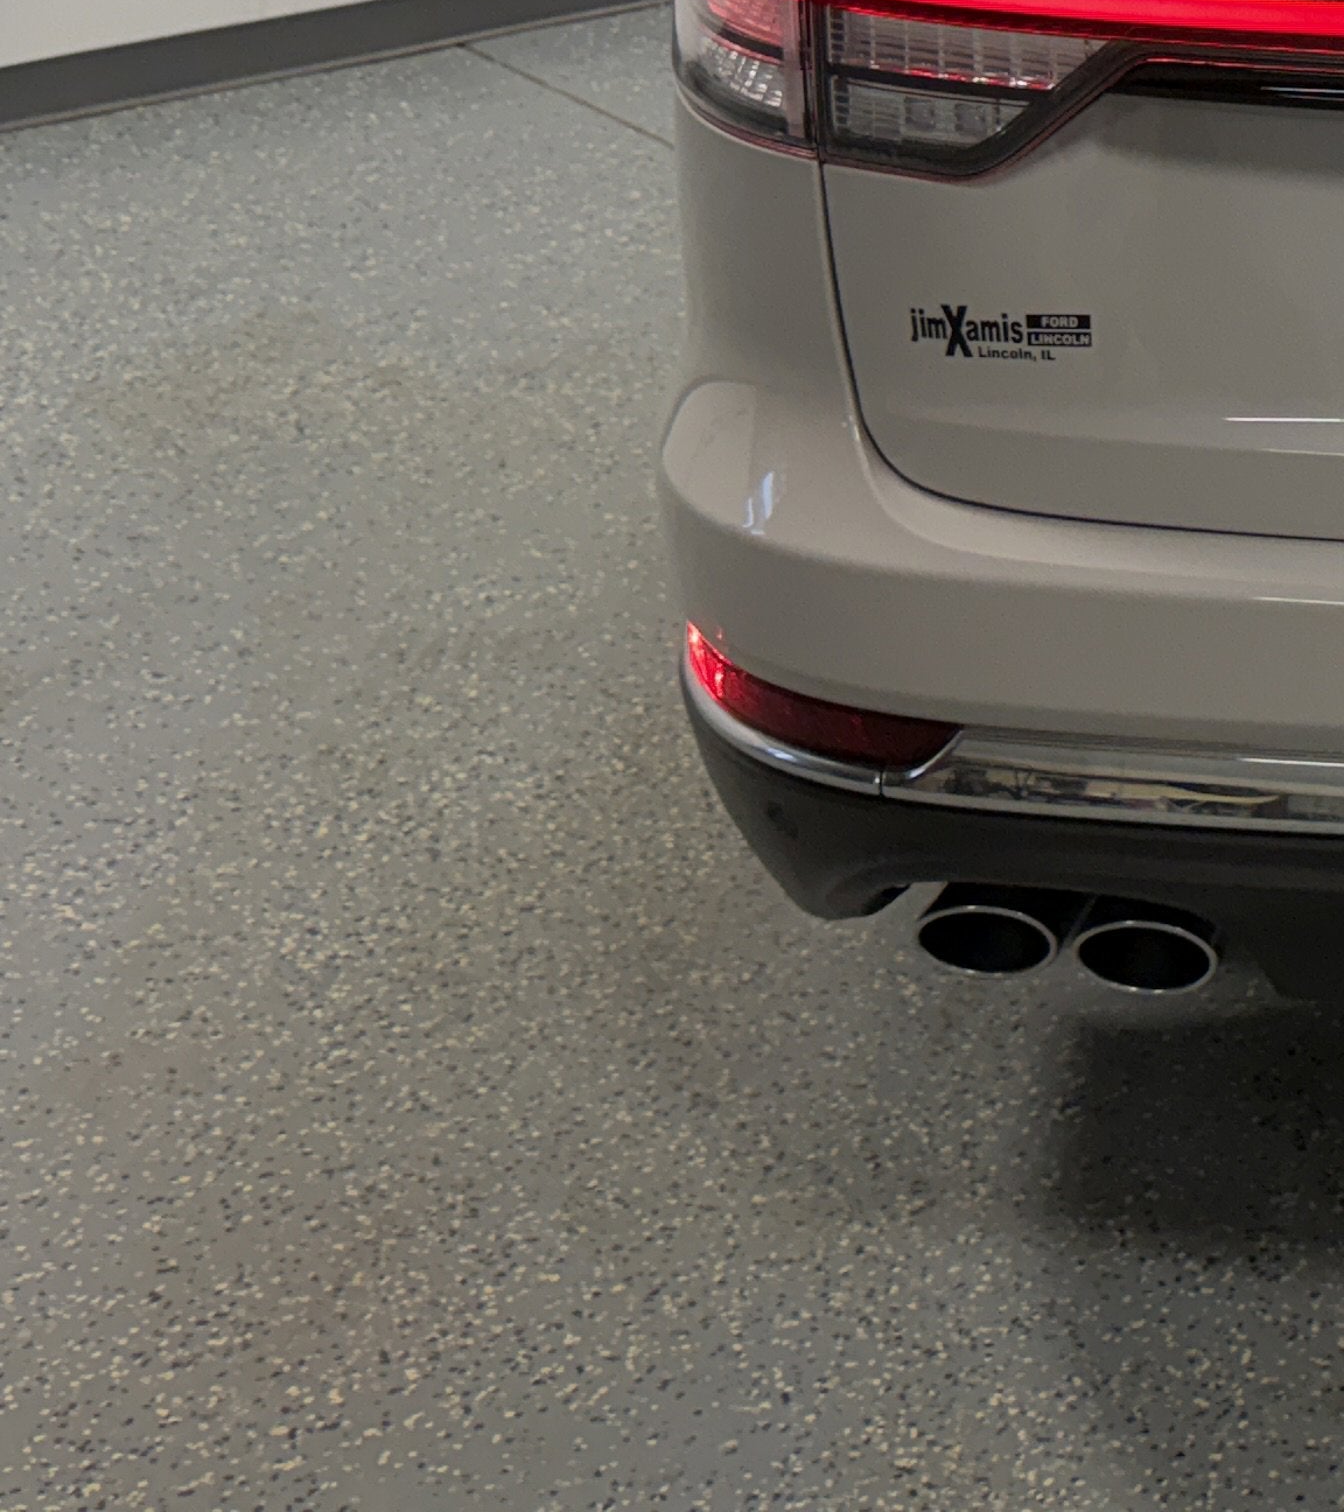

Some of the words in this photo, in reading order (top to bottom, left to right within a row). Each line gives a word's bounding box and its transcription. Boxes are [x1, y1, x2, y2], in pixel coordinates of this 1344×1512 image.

[1040, 315, 1080, 329] FORD
[1029, 332, 1091, 346] LINCOLN
[977, 345, 1038, 362] Lincoln,
[1041, 348, 1057, 361] IL
